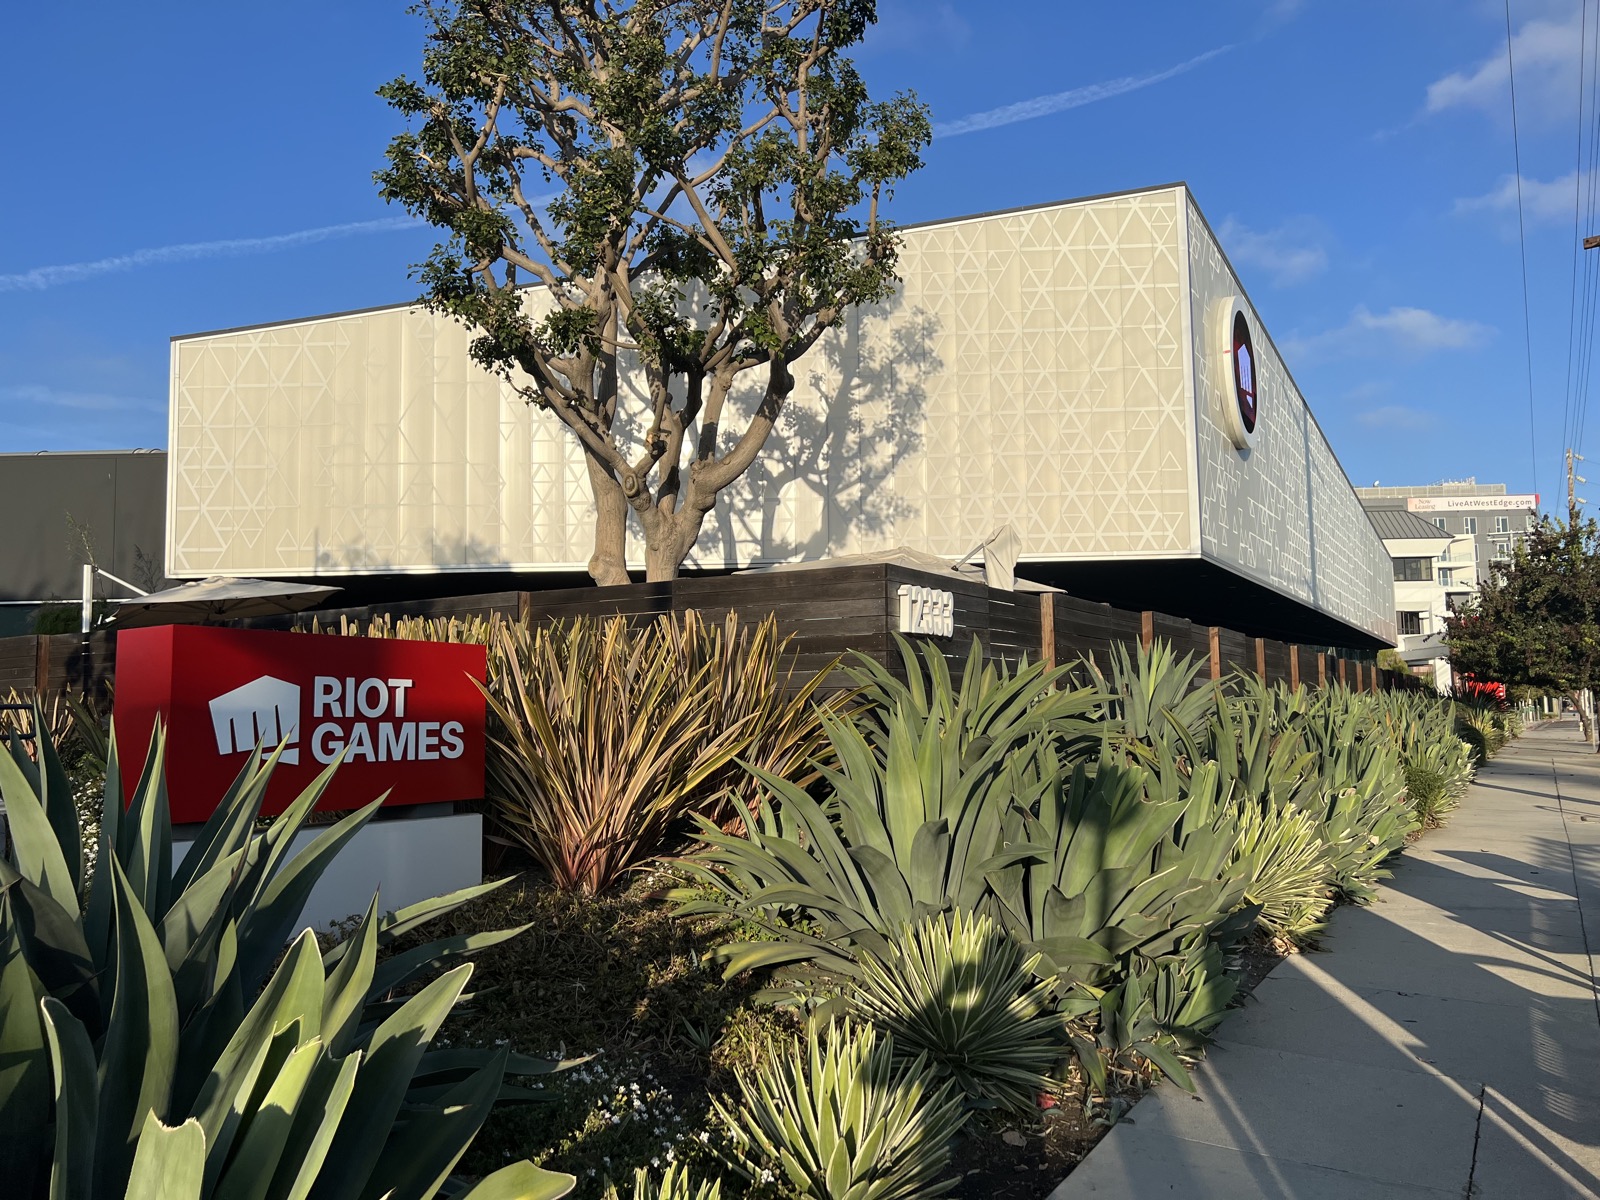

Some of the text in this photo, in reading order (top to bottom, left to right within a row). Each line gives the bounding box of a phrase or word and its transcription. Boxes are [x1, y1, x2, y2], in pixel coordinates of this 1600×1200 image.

[1447, 499, 1532, 508] LiveAtWestEdge.com
[898, 584, 954, 638] 12333
[313, 675, 413, 718] RIOT
[311, 721, 465, 765] GAMES
